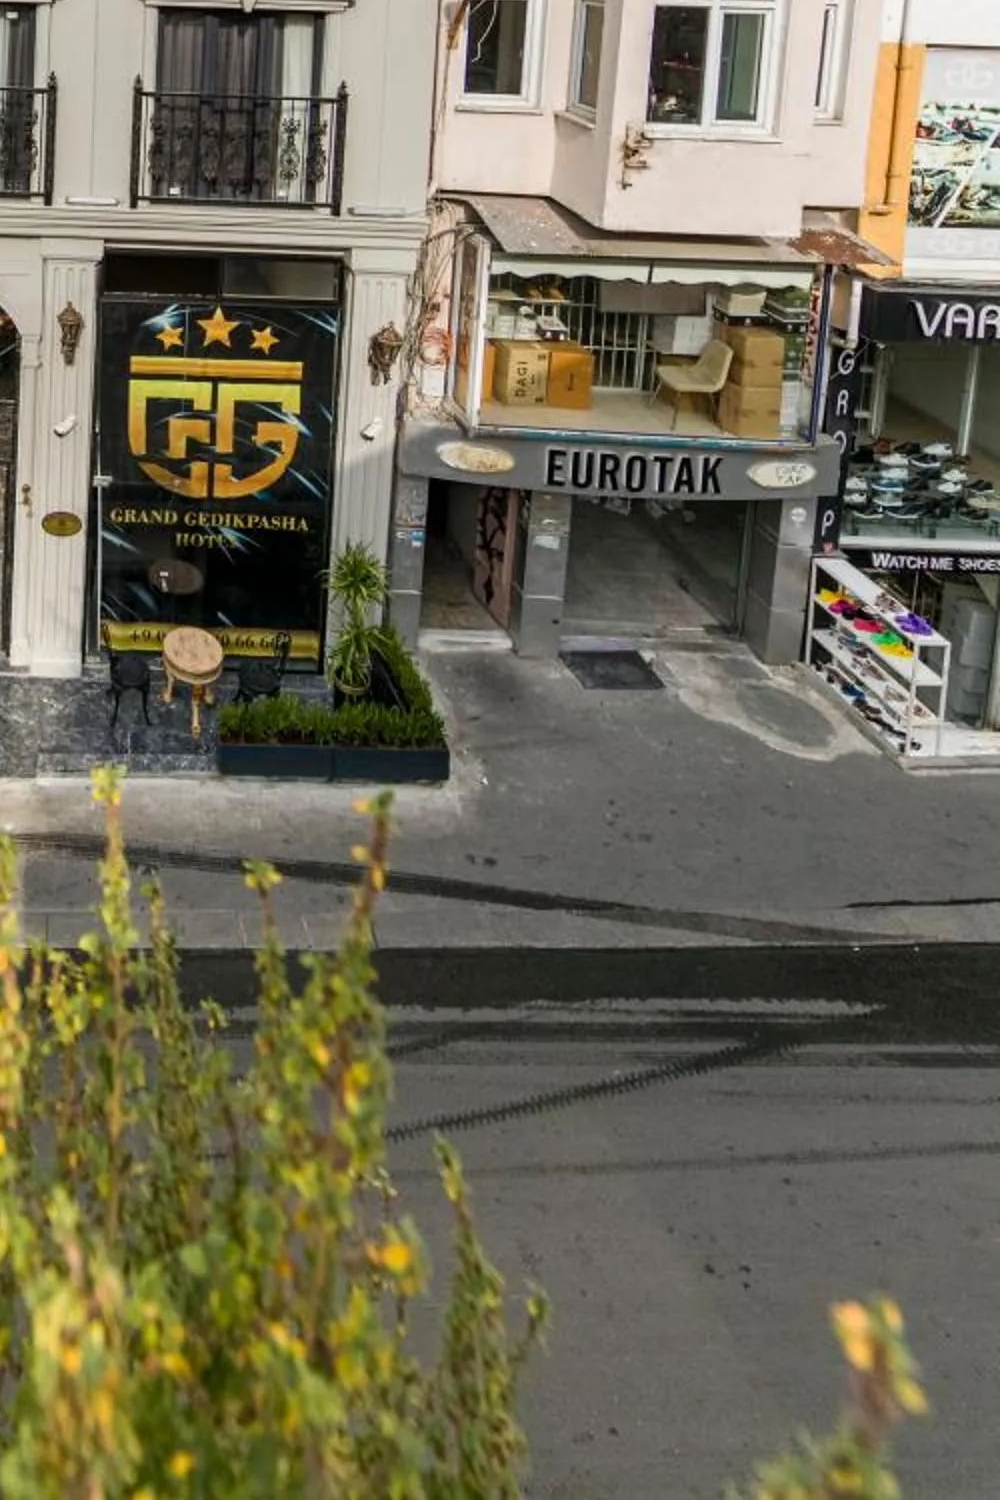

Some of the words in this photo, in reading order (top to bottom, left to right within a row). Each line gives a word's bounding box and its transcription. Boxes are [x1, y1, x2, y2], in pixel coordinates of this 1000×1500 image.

[546, 448, 724, 494] EUROTAK
[110, 507, 178, 525] GRAND
[184, 511, 309, 532] GEDIKPASHA
[930, 556, 954, 571] ME
